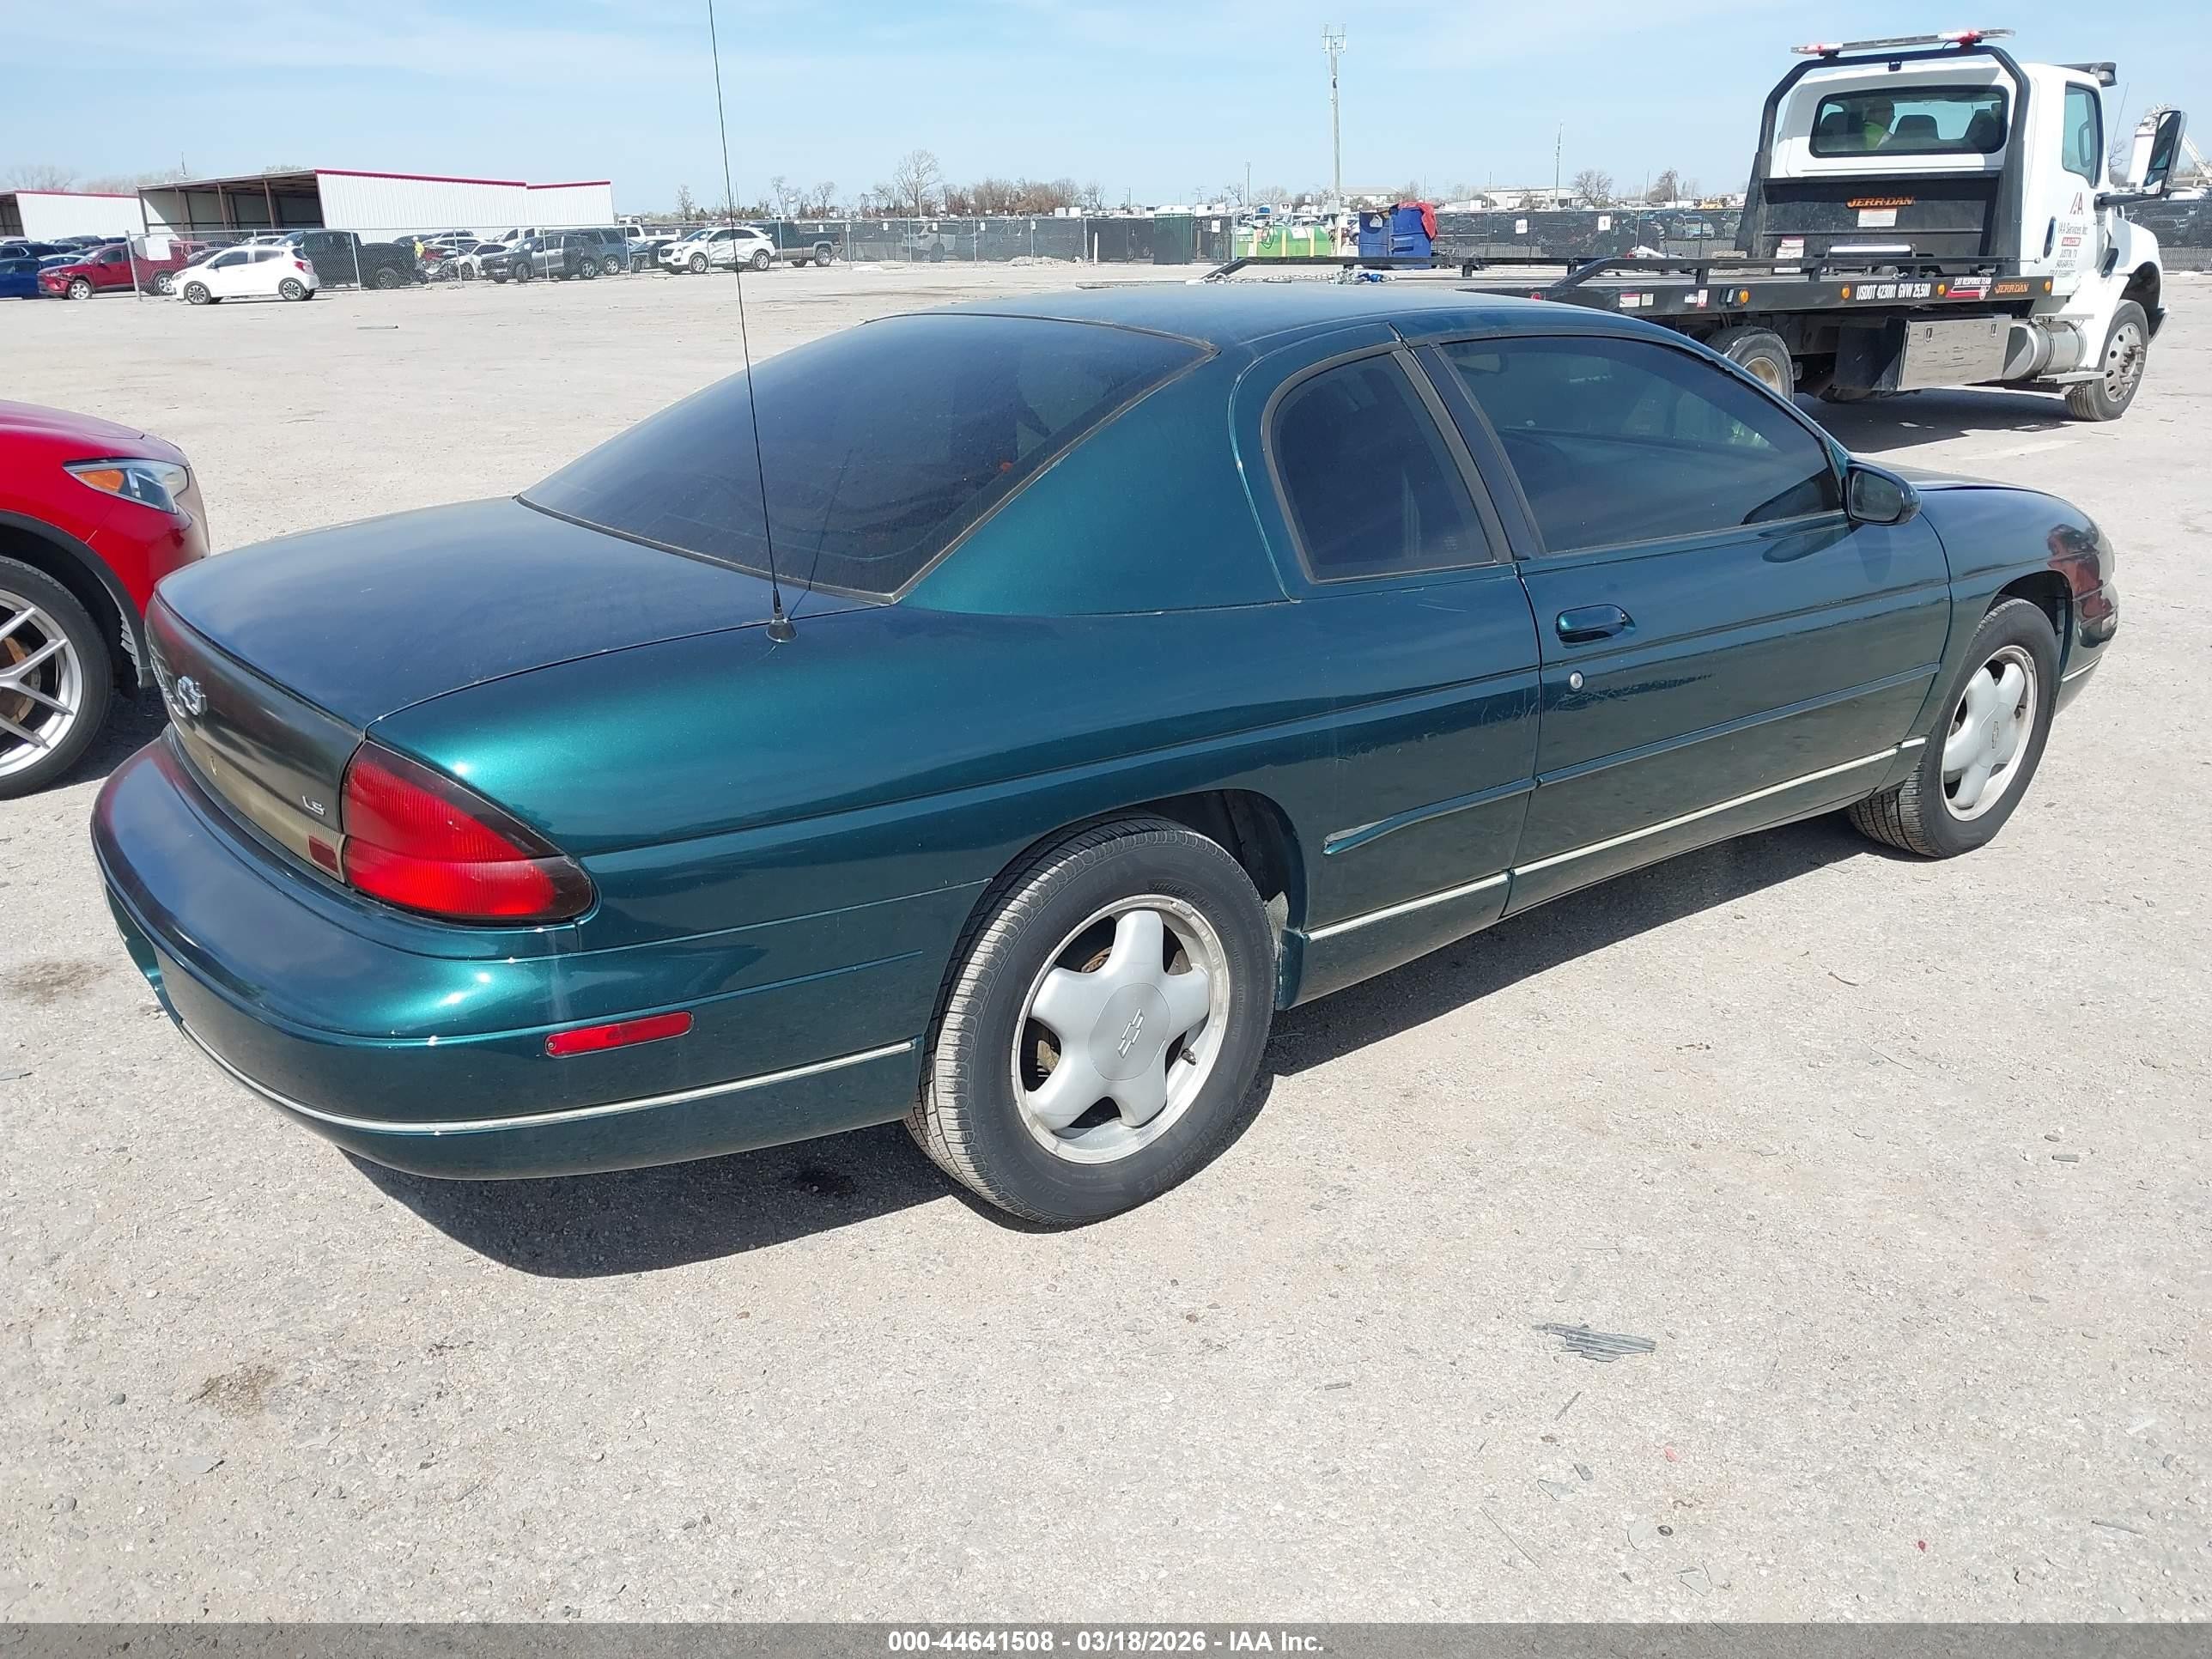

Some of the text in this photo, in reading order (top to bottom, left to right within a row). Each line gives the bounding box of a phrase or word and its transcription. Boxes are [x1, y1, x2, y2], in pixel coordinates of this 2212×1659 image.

[1856, 284, 1877, 301] USDOT
[1898, 283, 1913, 299] GVW
[302, 795, 325, 816] LS
